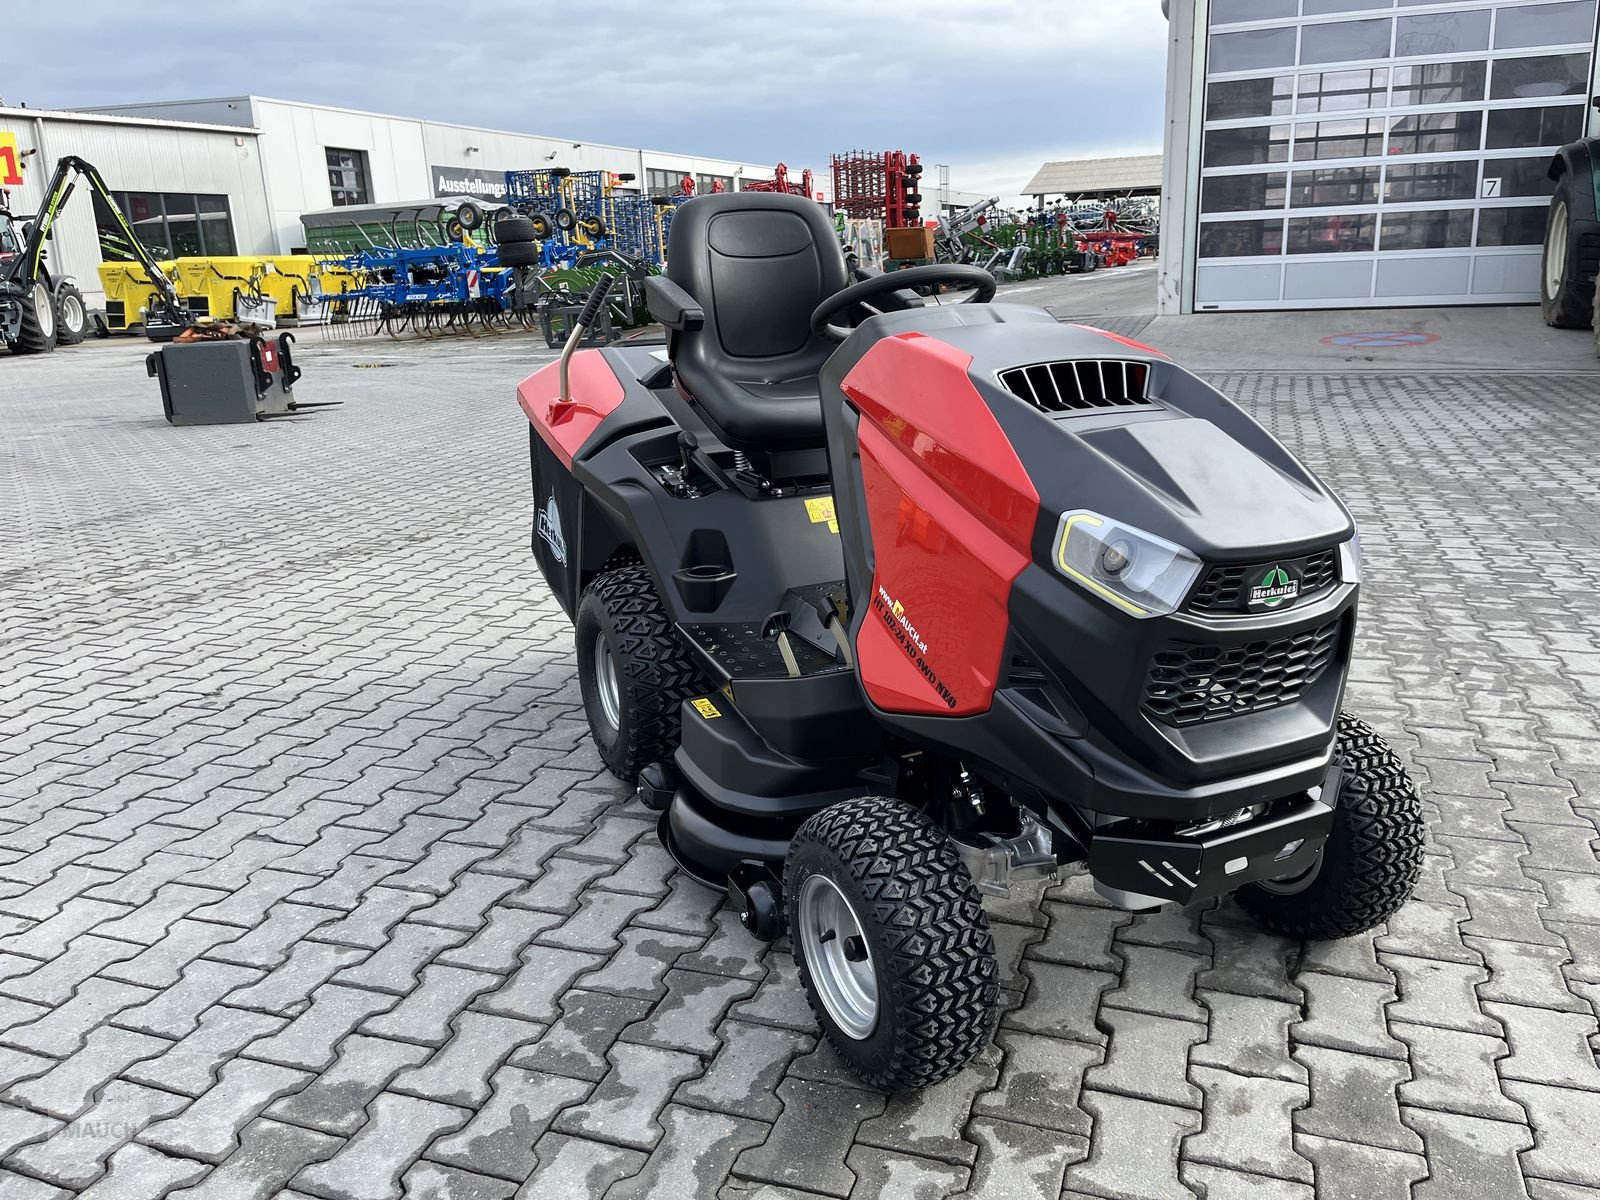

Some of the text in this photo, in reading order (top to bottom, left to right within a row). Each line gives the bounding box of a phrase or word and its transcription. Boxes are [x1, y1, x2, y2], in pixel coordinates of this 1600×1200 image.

[1486, 180, 1497, 196] 7
[1252, 584, 1297, 599] Herkules
[878, 585, 928, 654] www.MAUCH.at
[882, 611, 906, 644] 102-24
[904, 641, 917, 659] XD
[916, 658, 937, 684] 4WD
